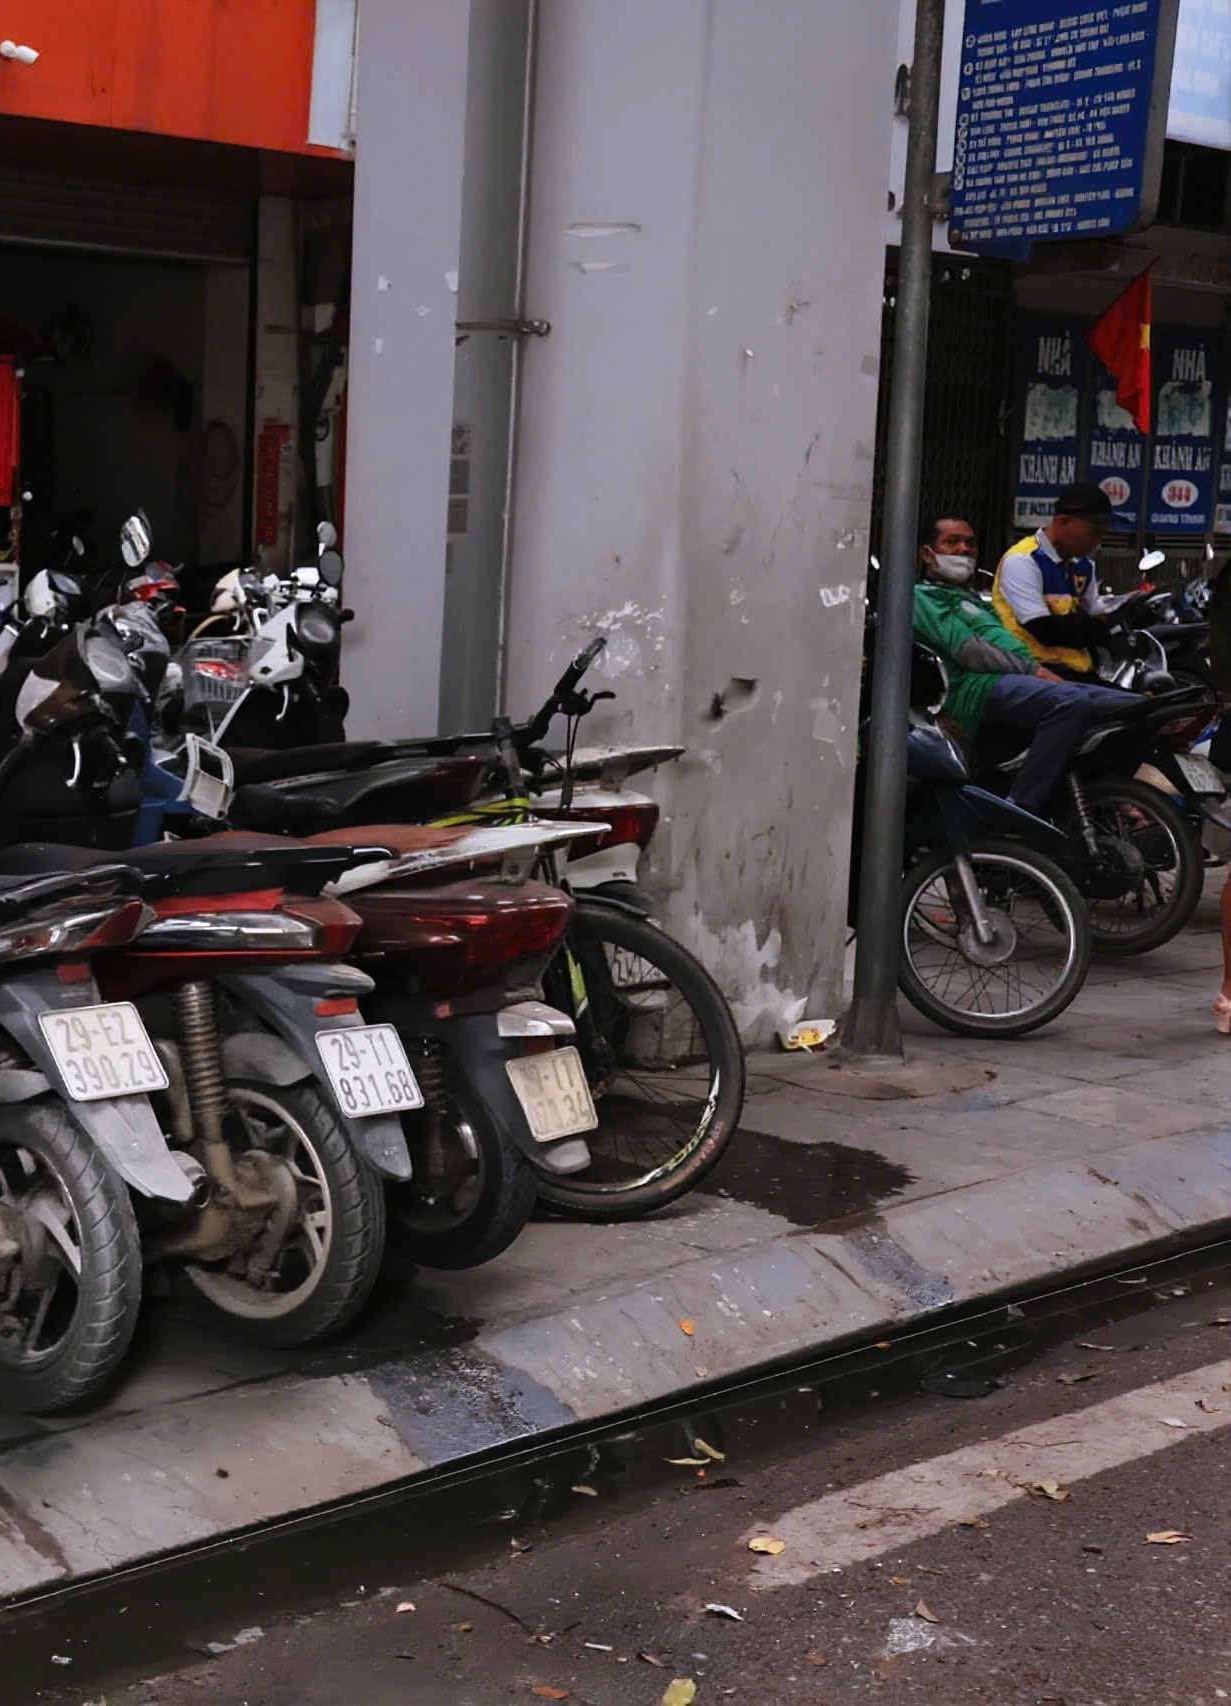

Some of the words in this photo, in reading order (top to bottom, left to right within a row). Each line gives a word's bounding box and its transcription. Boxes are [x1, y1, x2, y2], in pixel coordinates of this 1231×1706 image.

[56, 1011, 135, 1053] 29-E2
[330, 1031, 394, 1071] 29-Y1
[66, 1050, 159, 1094] 390.29
[339, 1069, 415, 1111] 831.68
